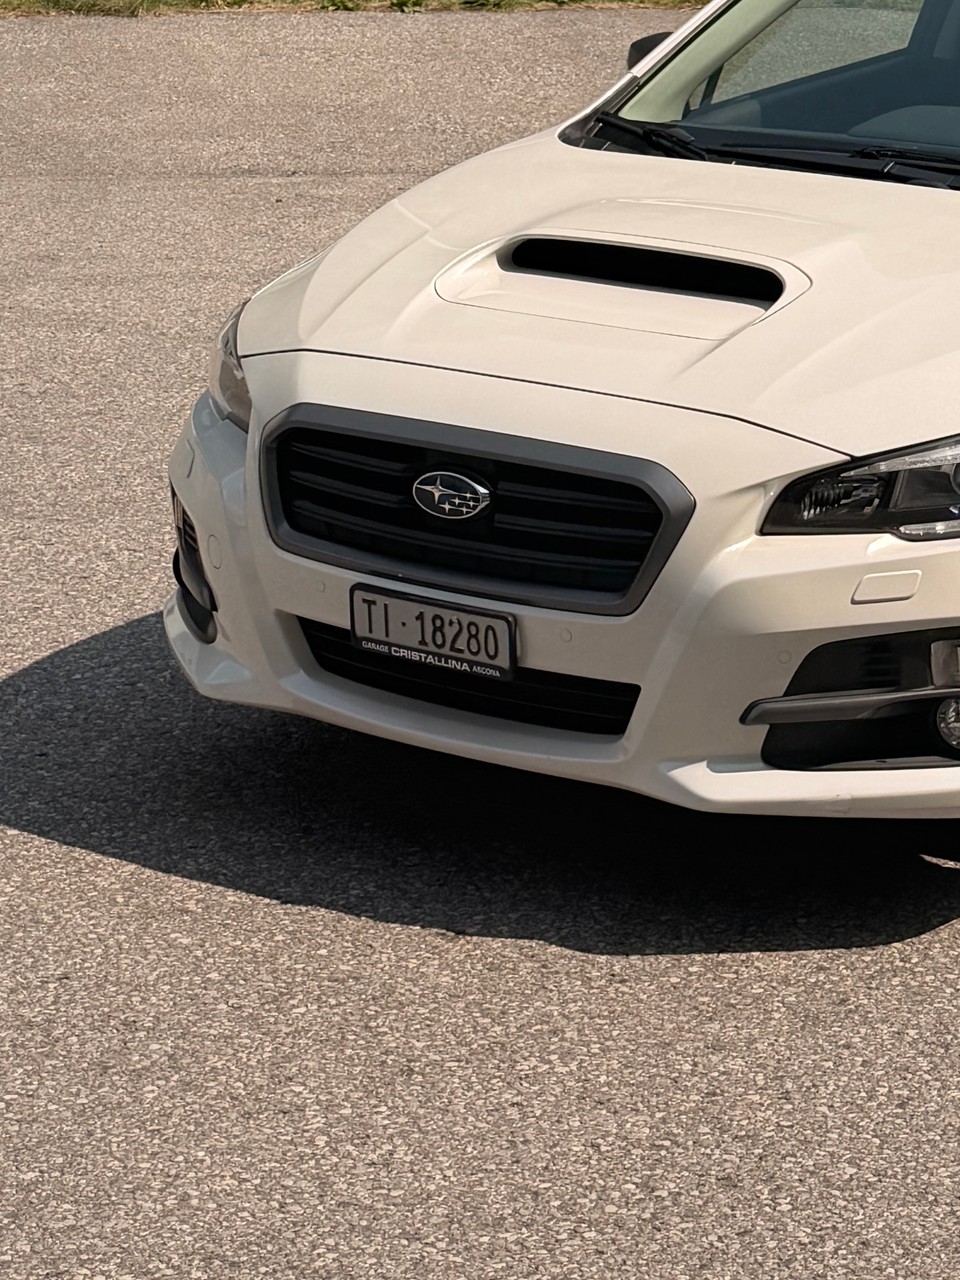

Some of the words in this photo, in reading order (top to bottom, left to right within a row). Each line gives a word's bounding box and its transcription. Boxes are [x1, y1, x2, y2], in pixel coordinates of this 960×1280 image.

[362, 640, 389, 654] GARAGE
[391, 646, 471, 672] CRISTALLINA
[472, 665, 501, 678] ASCONA
